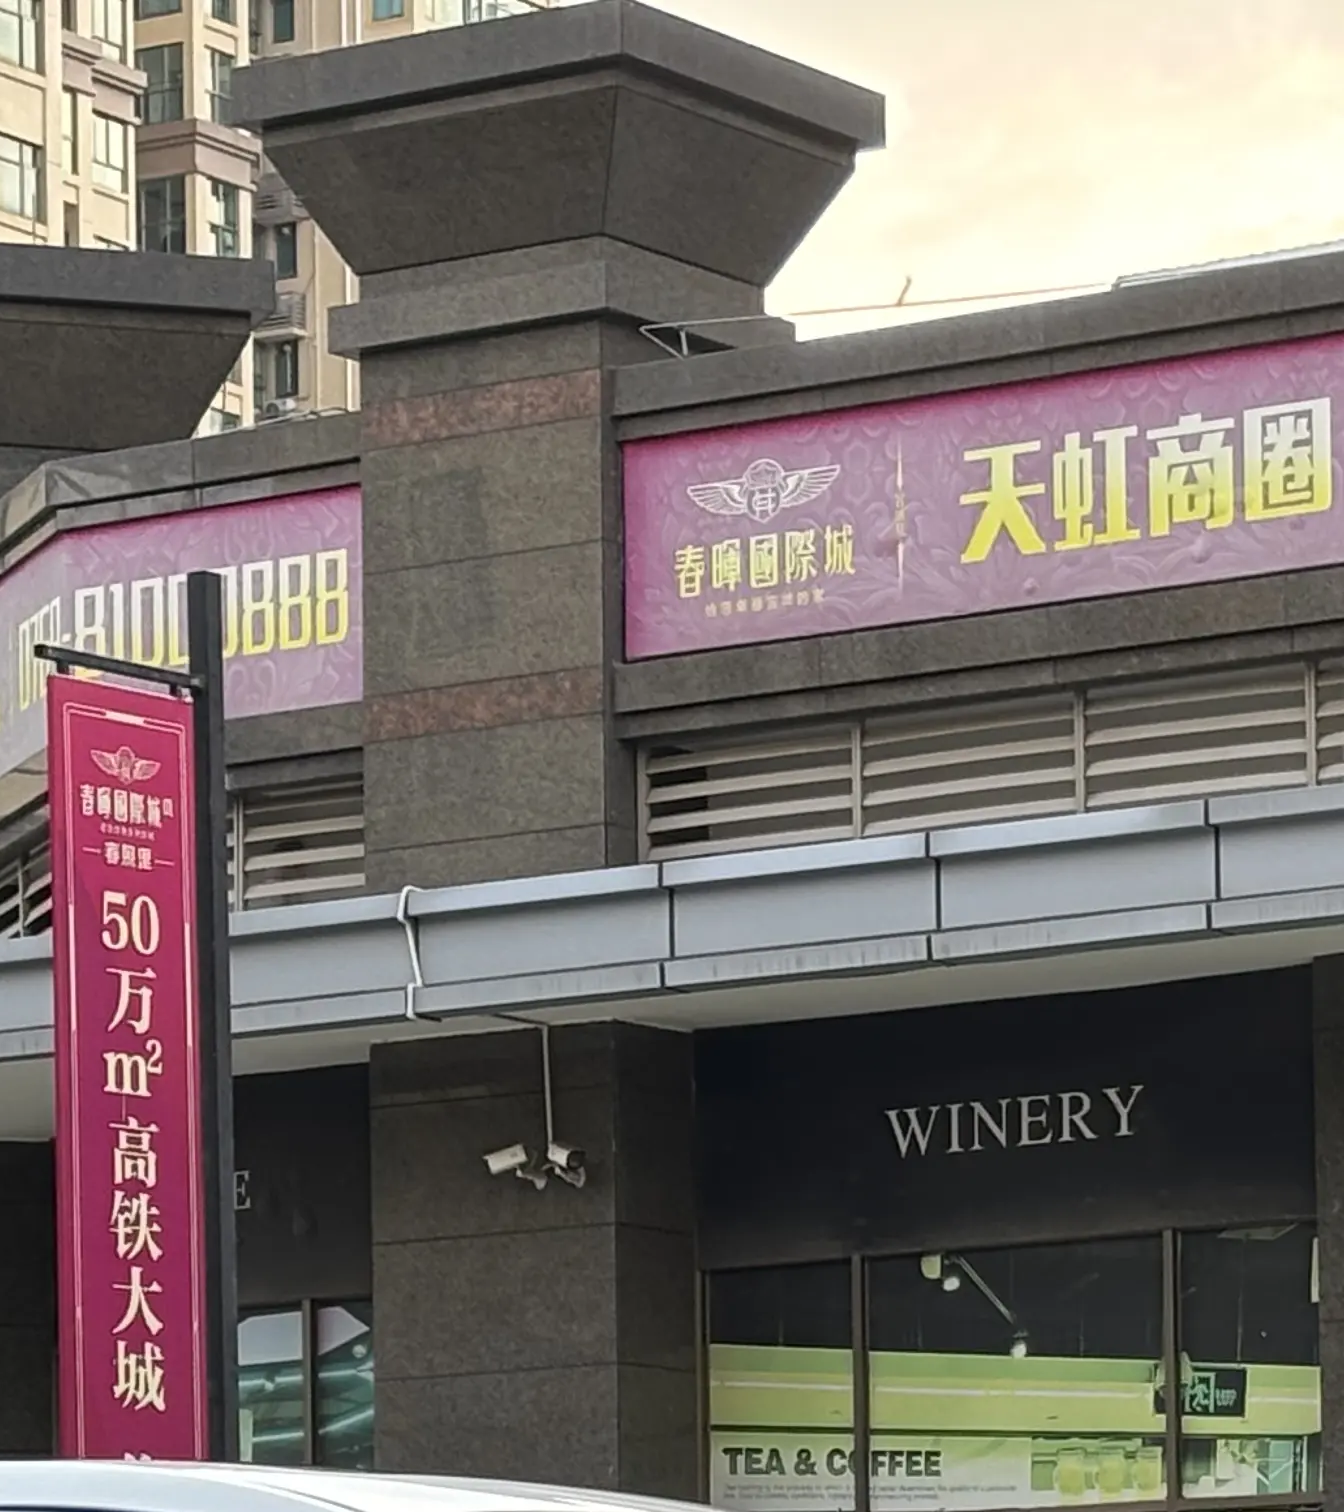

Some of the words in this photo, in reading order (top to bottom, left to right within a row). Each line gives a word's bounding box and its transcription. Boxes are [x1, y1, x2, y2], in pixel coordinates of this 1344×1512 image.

[958, 397, 1333, 564] 天虹商圈
[884, 1085, 1144, 1159] WINERY
[722, 1447, 786, 1476] TEA
[793, 1448, 818, 1476] &
[826, 1447, 942, 1477] CFFEE
